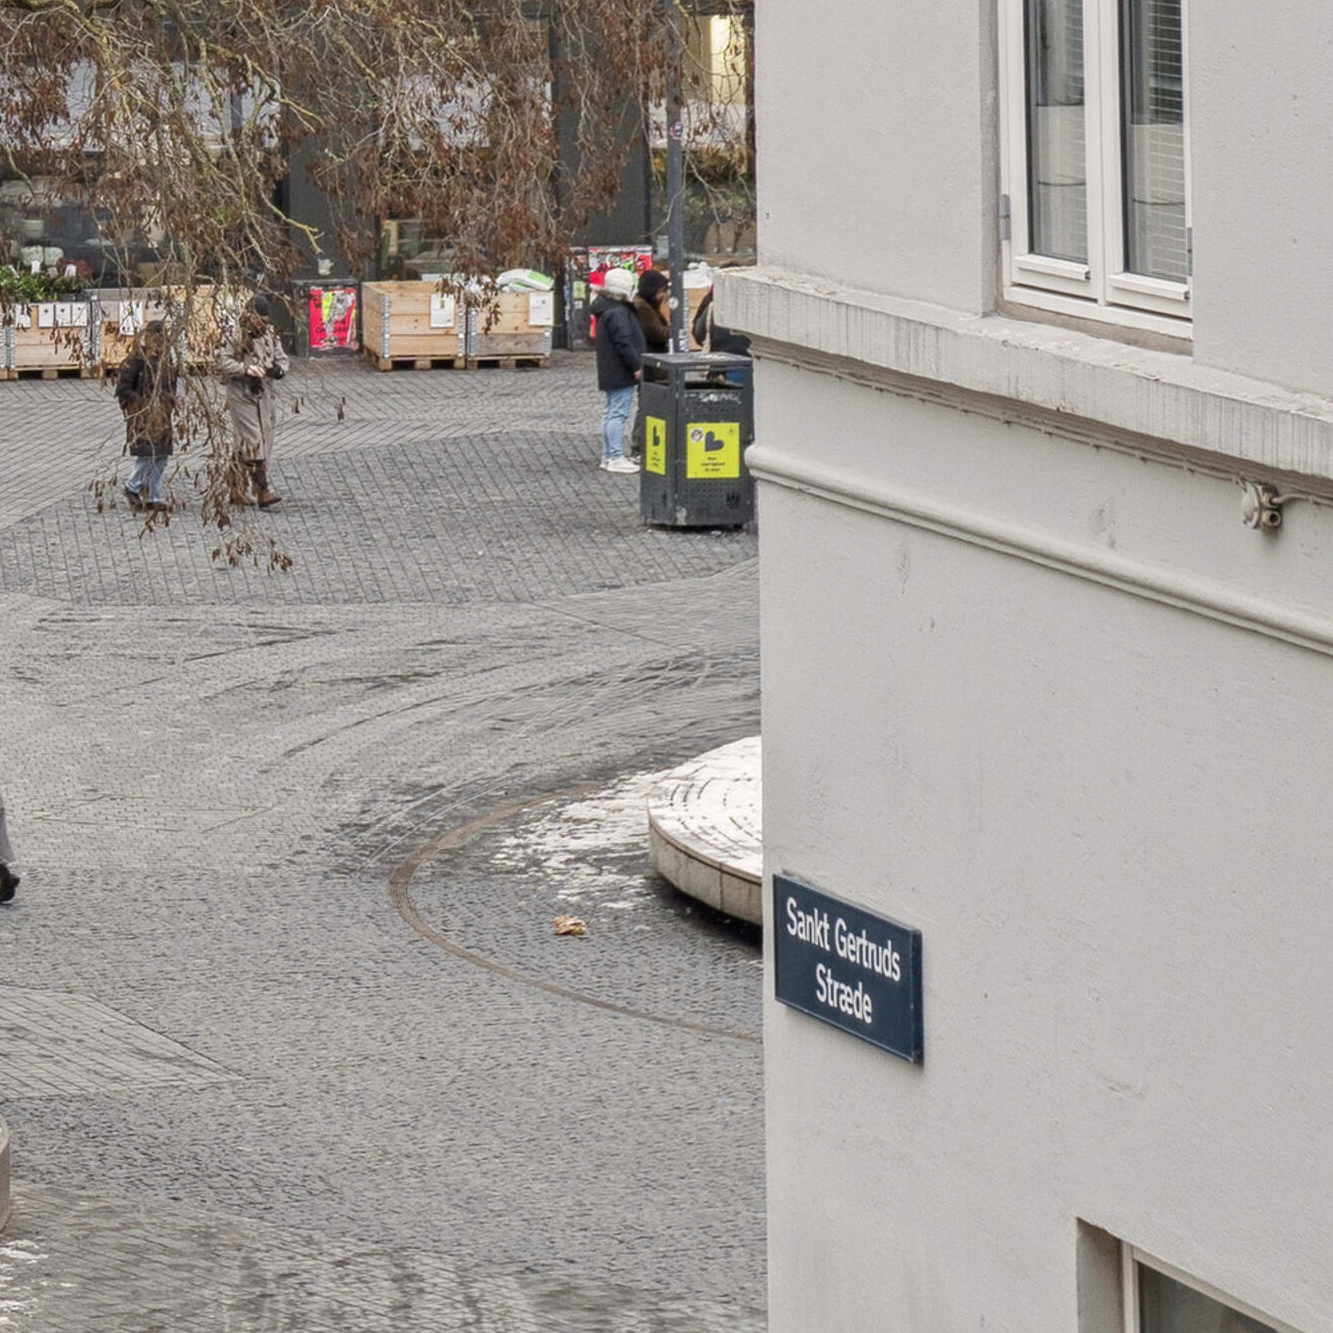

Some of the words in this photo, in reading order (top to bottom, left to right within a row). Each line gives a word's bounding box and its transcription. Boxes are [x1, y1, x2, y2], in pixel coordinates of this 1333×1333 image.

[786, 896, 830, 952] Sankt
[835, 917, 901, 982] Gertruds
[815, 963, 873, 1025] Stræde
